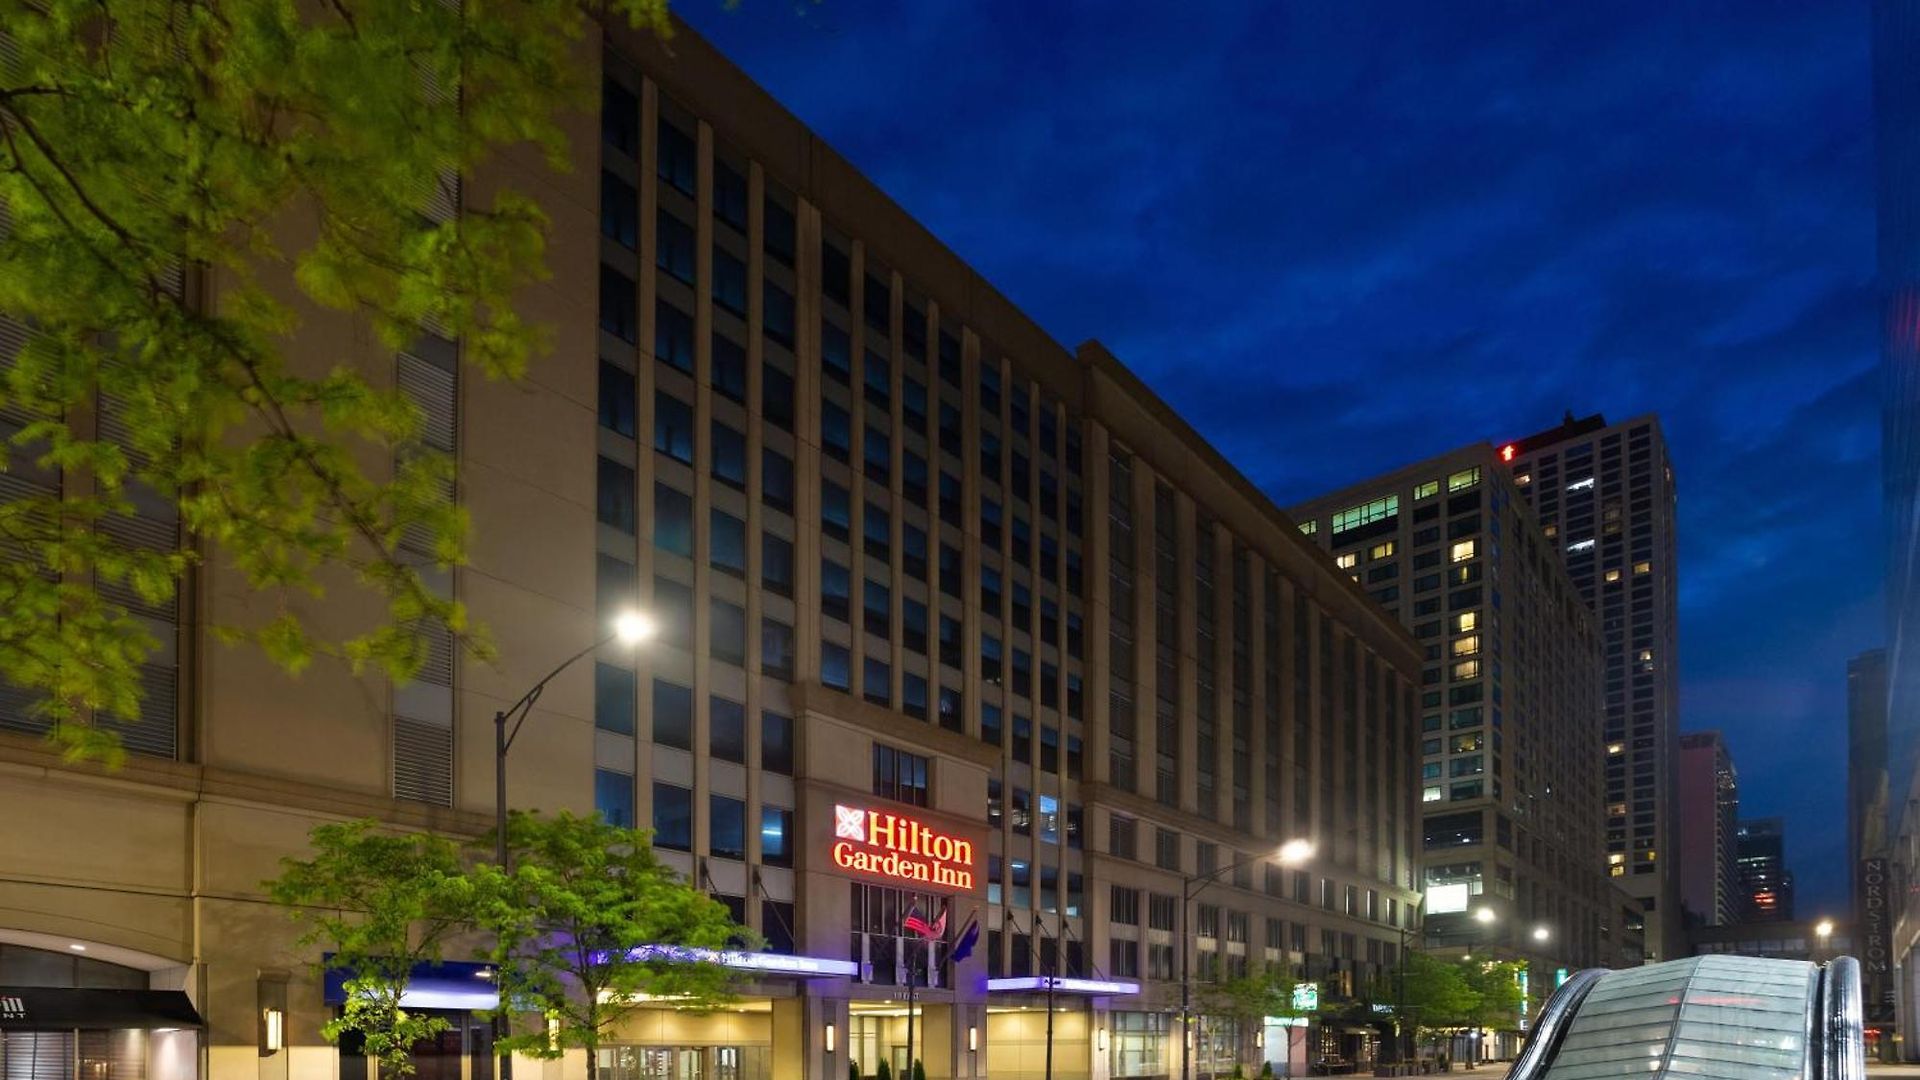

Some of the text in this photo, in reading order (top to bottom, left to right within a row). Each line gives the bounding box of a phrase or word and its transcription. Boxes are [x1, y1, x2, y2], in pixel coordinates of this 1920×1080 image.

[868, 811, 972, 865] Hilton
[834, 842, 973, 889] Garden Inn
[1865, 861, 1886, 972] NORDSTROM
